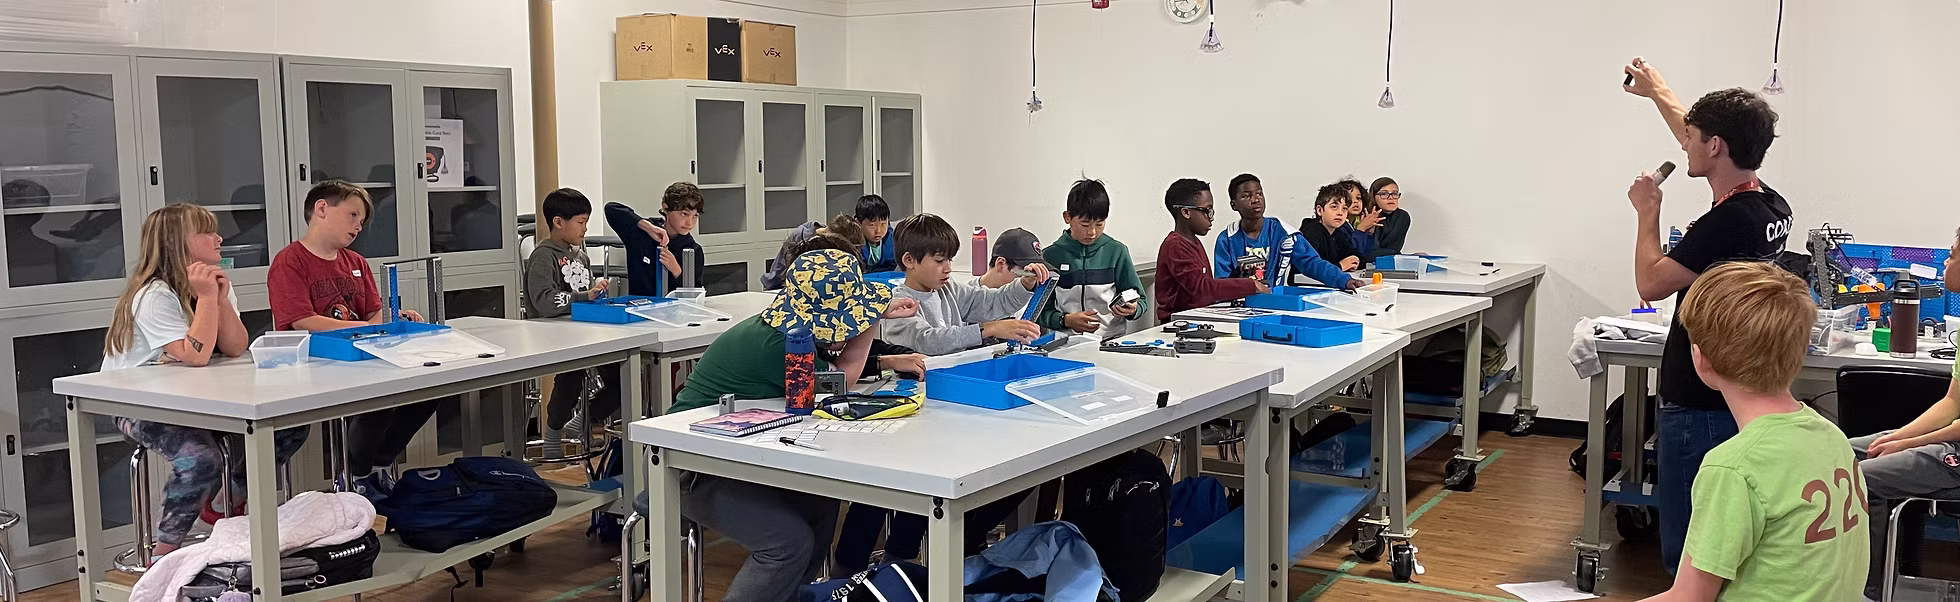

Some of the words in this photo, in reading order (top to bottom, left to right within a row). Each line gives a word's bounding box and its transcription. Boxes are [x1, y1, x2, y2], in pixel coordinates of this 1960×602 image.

[633, 41, 653, 52] VEX
[714, 44, 735, 56] VEX
[762, 47, 782, 58] VEX
